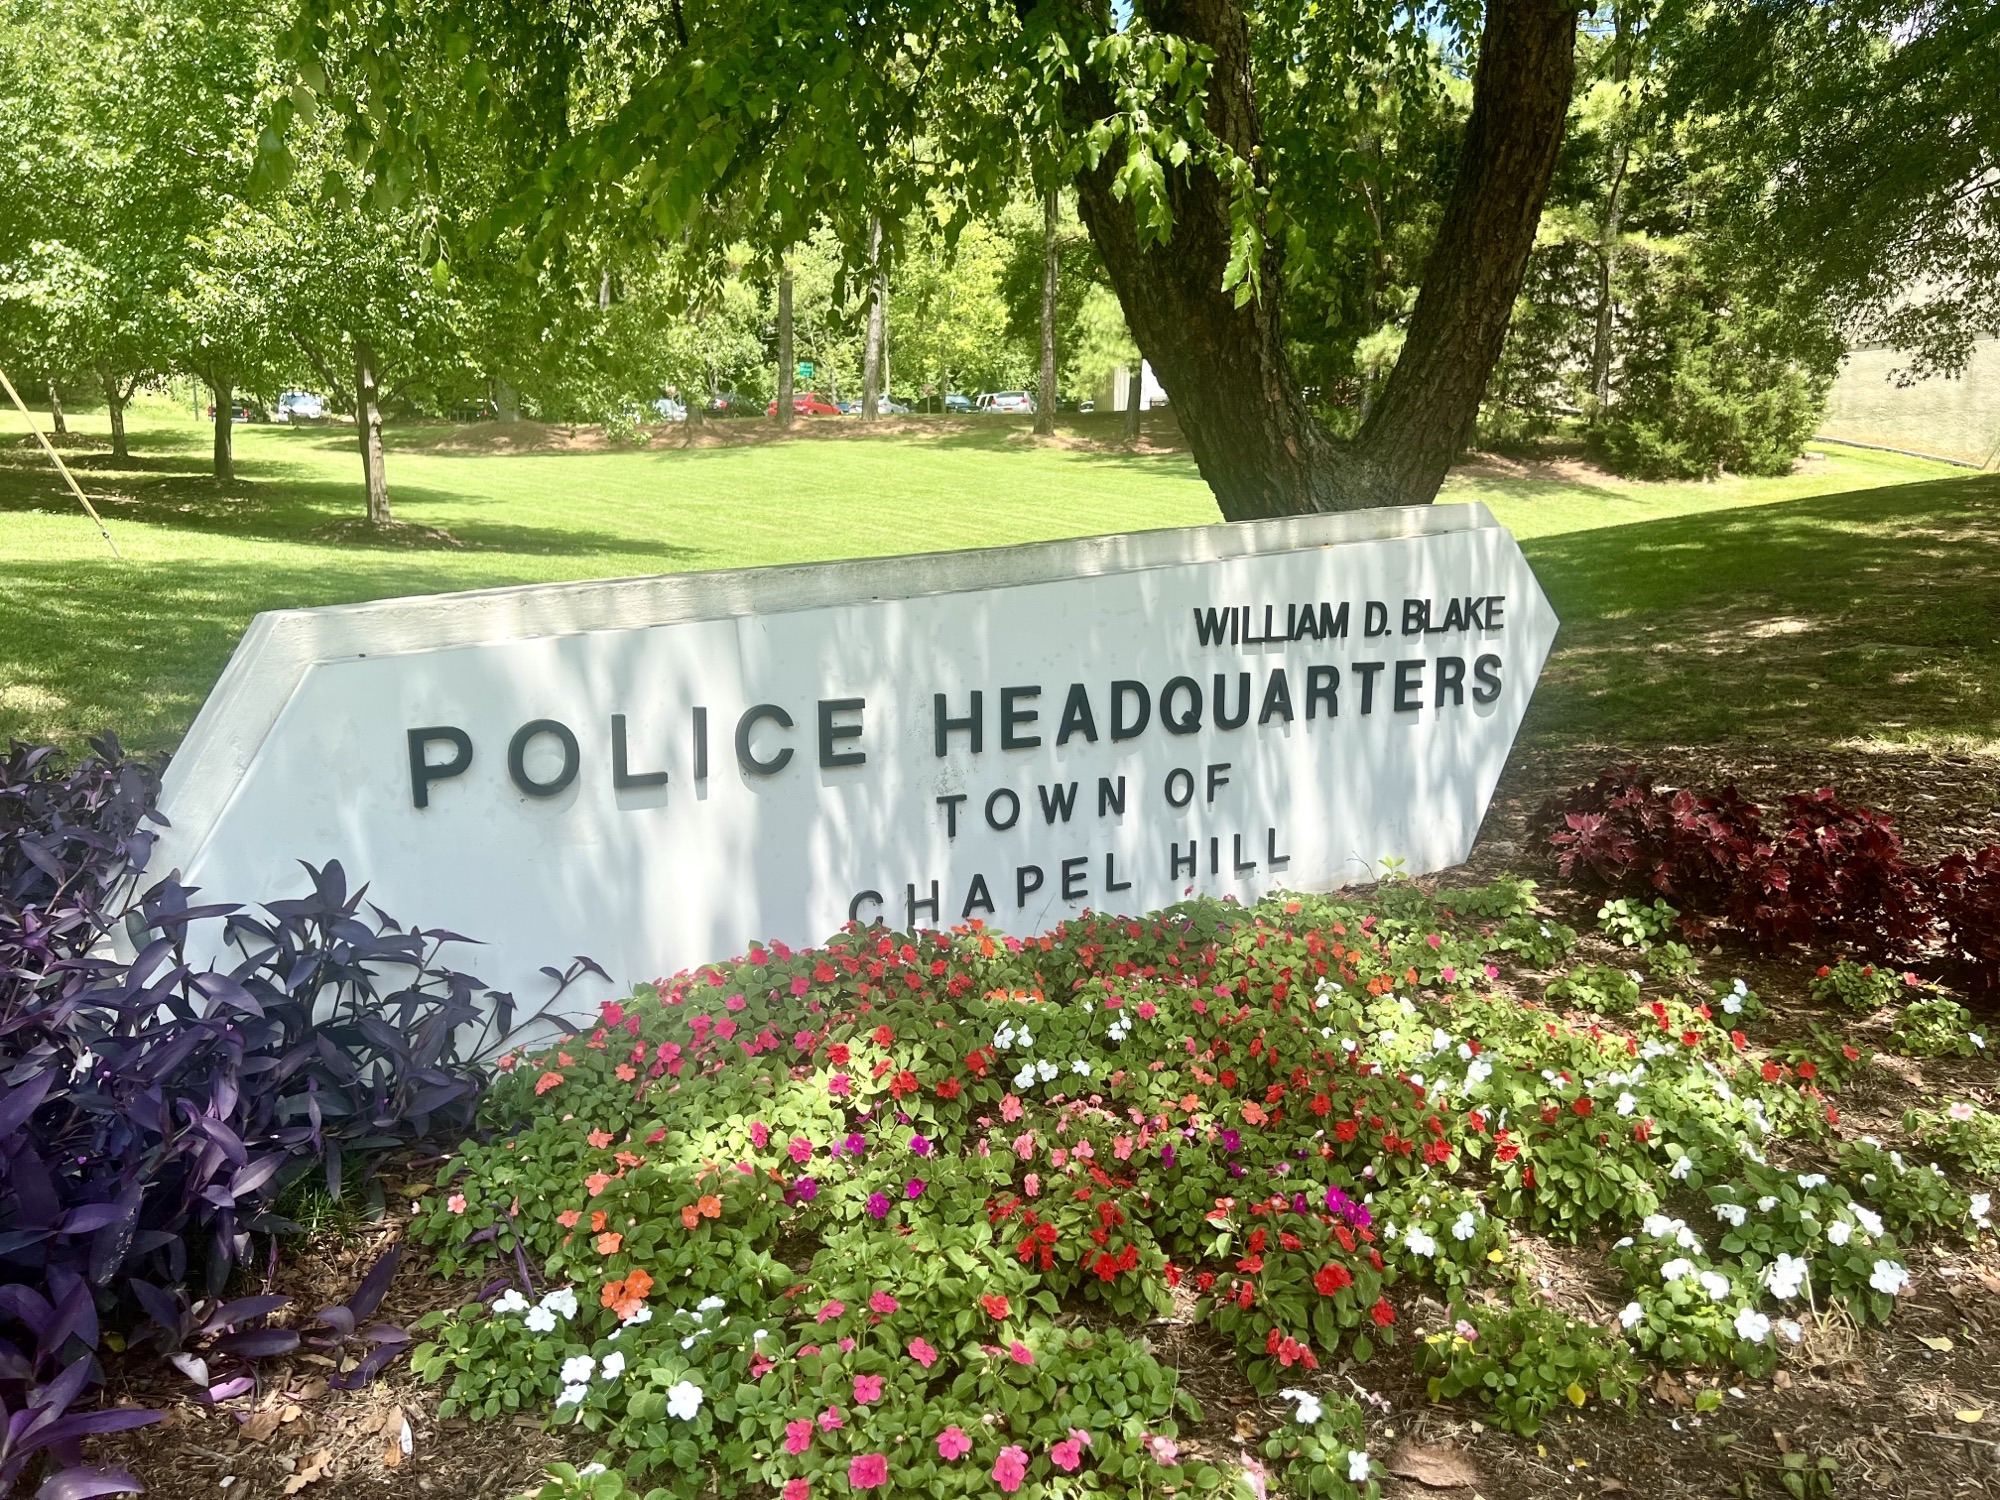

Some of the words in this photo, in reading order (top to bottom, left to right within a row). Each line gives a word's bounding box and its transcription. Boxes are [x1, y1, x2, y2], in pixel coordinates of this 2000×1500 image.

[1194, 602, 1349, 646] WILLIAM
[1365, 601, 1392, 637] D.
[1402, 596, 1505, 636] BLAKE
[408, 697, 866, 808] POLICE
[934, 653, 1502, 757] HEADQUARTERS
[936, 776, 1126, 837] TOWN
[1164, 763, 1231, 807] OF
[848, 852, 1132, 926] CHAPEL
[1170, 828, 1291, 880] HILL
